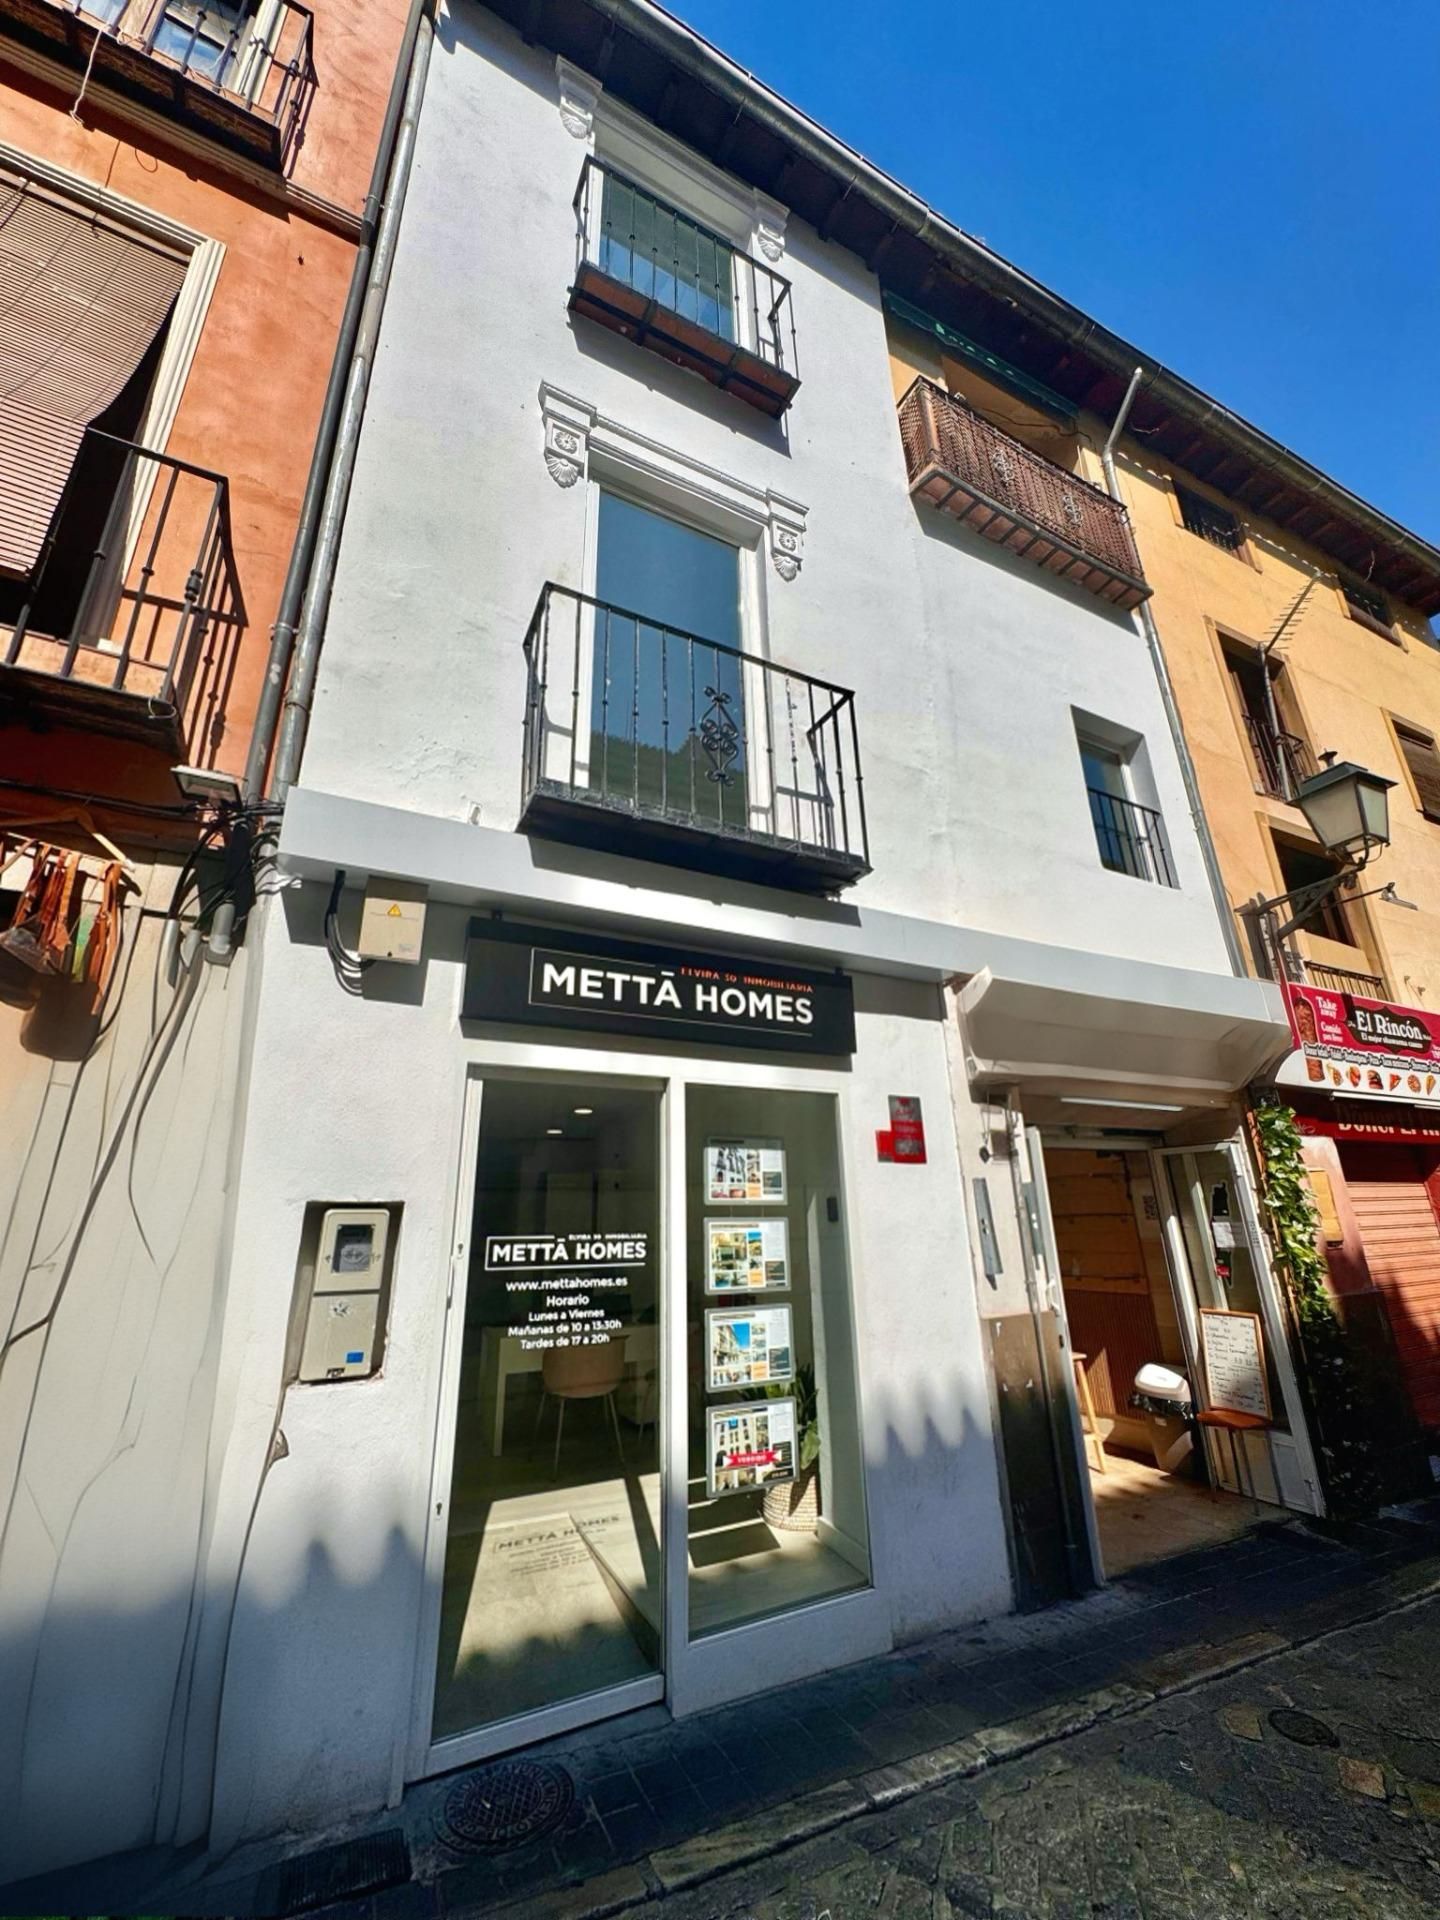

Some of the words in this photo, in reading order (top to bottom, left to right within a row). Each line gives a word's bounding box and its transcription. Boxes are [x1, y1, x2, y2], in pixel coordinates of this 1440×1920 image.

[695, 983, 813, 1025] HOMES
[1355, 1010, 1373, 1032] El
[1374, 1013, 1423, 1040] Rincón
[575, 1241, 647, 1260] HOMES
[505, 1277, 628, 1291] www.mettahomes.es
[546, 1294, 590, 1307] Horario
[528, 1311, 558, 1322] Lunes
[560, 1312, 567, 1320] a
[568, 1309, 605, 1319] Viernes
[508, 1325, 554, 1337] Mañanas
[556, 1323, 569, 1334] de
[571, 1322, 582, 1332] 10
[584, 1323, 590, 1331] a
[521, 1338, 554, 1350] Tardes
[556, 1336, 569, 1347] de
[571, 1334, 581, 1345] 17
[583, 1337, 590, 1345] a
[591, 1333, 610, 1344] 20h
